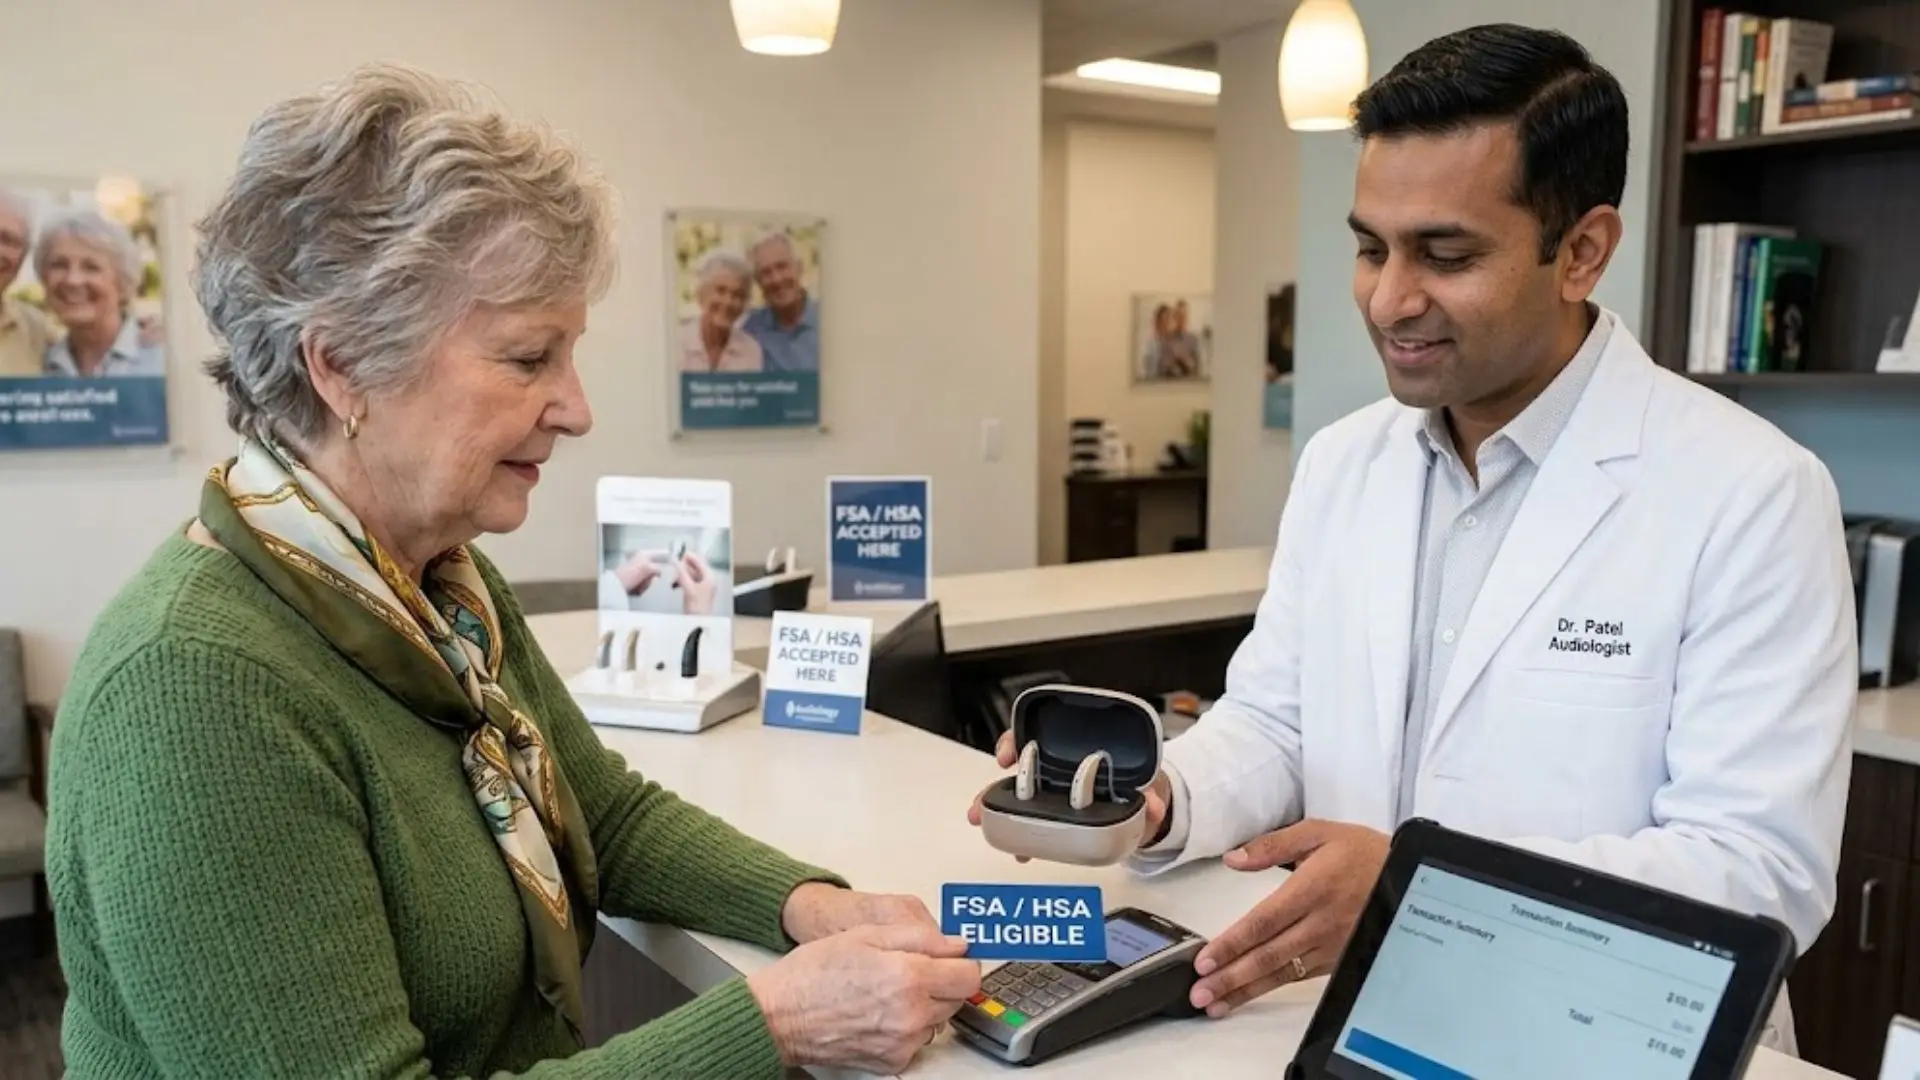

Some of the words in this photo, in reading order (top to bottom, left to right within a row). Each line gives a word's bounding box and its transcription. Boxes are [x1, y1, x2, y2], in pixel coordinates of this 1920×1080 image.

[836, 504, 871, 522] FSA
[872, 504, 883, 522] /
[884, 504, 923, 522] HSA
[836, 524, 923, 540] ACCEPTED
[857, 542, 902, 558] HERE
[1558, 617, 1578, 633] Dr.
[1584, 619, 1623, 636] Patel
[779, 626, 811, 643] FSA
[814, 628, 824, 646] /
[827, 631, 862, 648] HSA
[777, 647, 859, 665] ACCEPTED
[1548, 636, 1631, 658] Audiologist
[796, 667, 837, 682] HERE
[952, 896, 1007, 917] FSA
[1013, 897, 1025, 918] /
[1032, 898, 1092, 919] HSA
[960, 922, 1086, 945] ELIGIBLE
